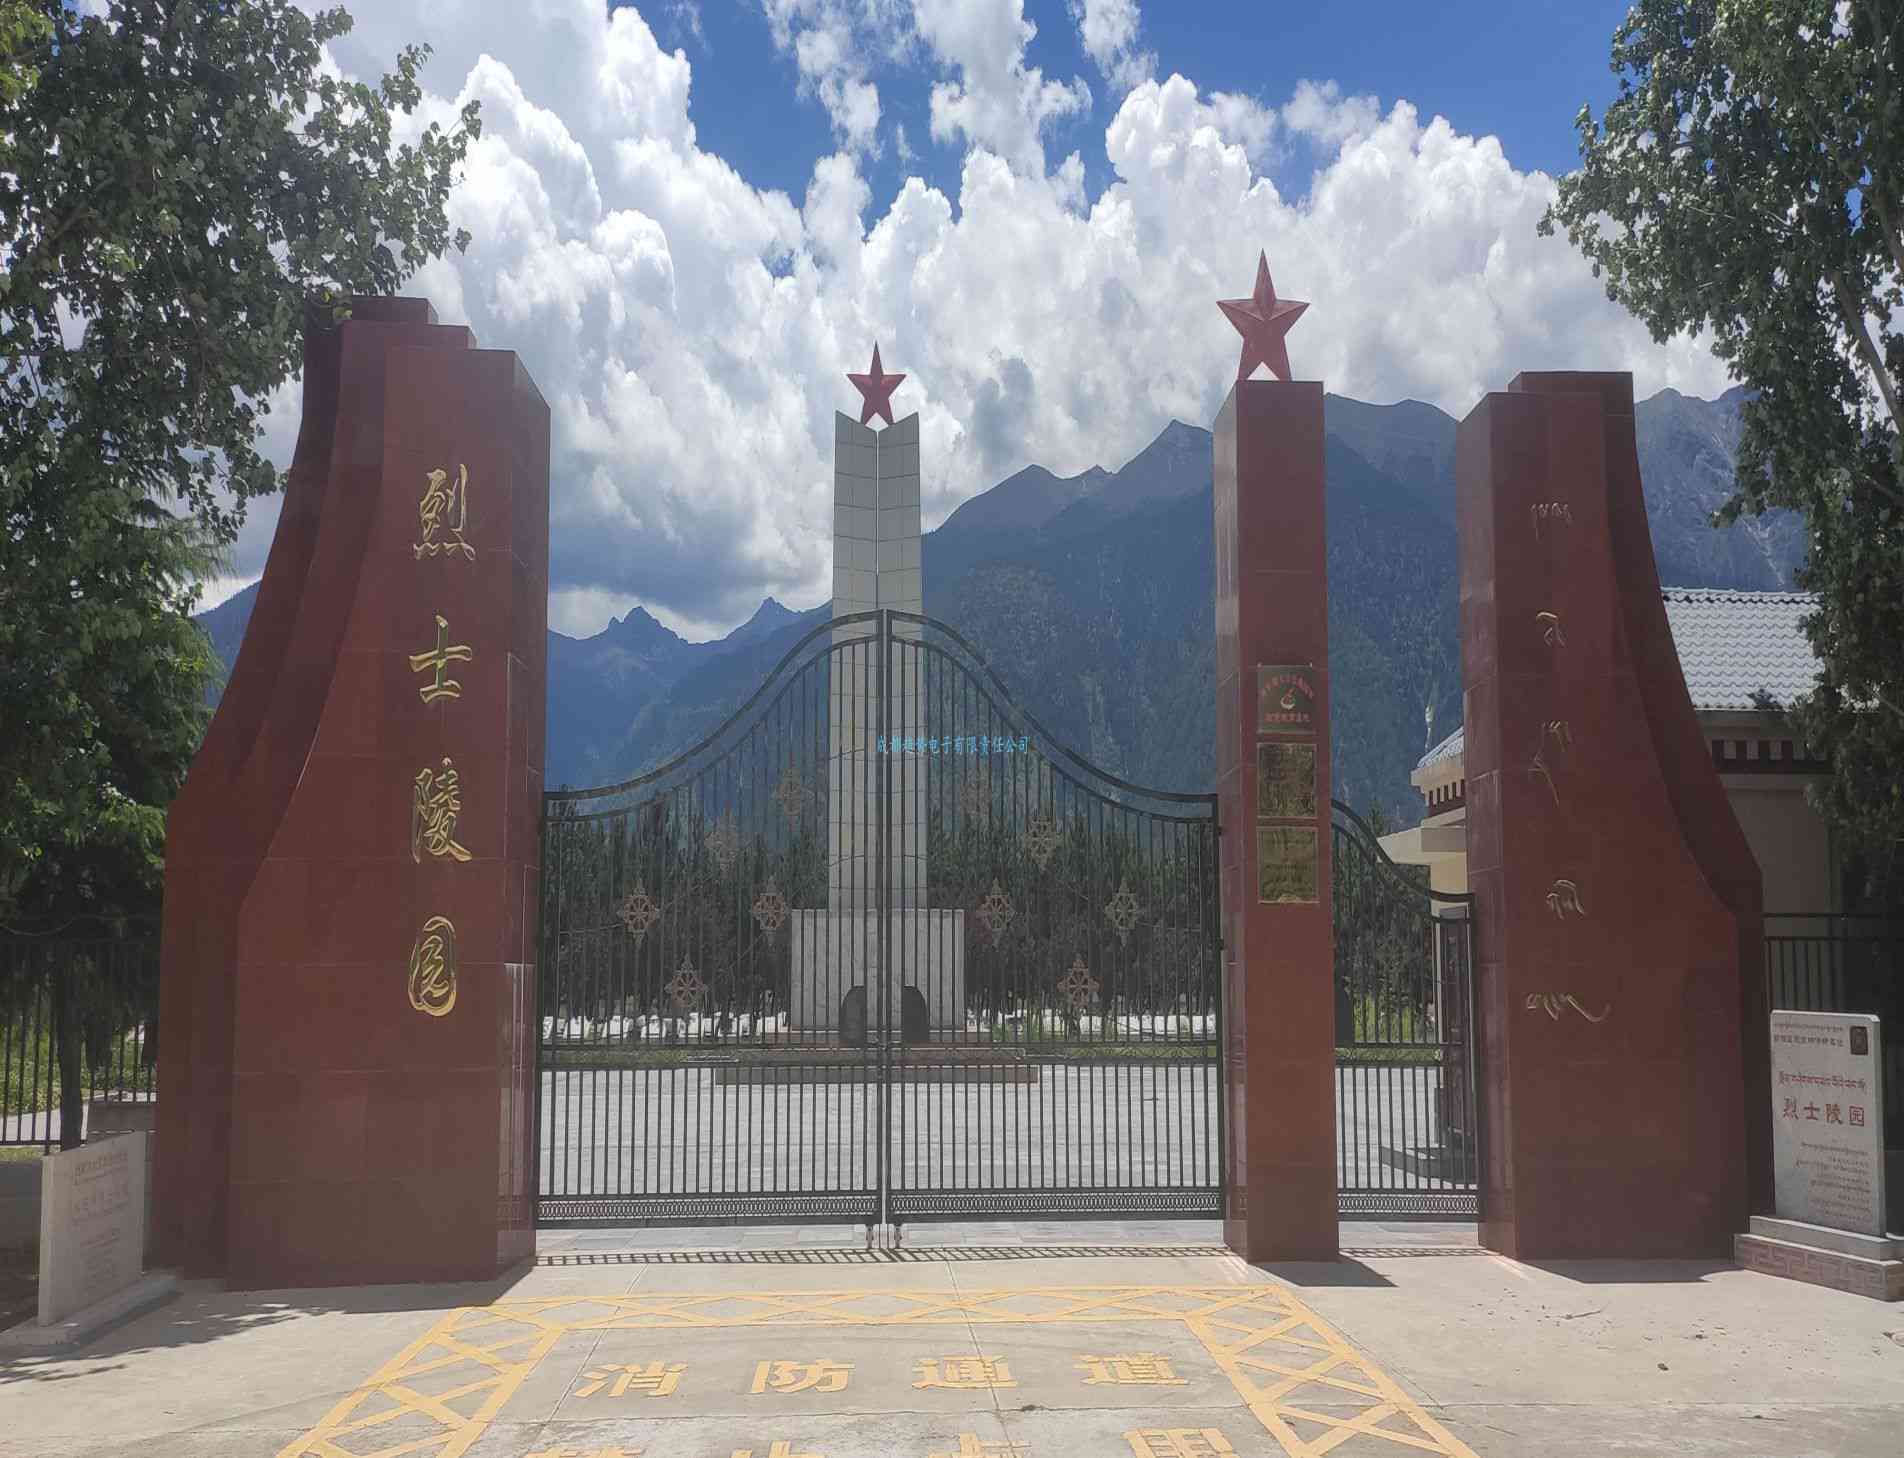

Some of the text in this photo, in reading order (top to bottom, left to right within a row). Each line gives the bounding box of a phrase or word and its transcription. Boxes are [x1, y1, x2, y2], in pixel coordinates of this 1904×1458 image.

[1783, 1097, 1865, 1127] 烈士陵园
[572, 1353, 1191, 1399] 消防通道
